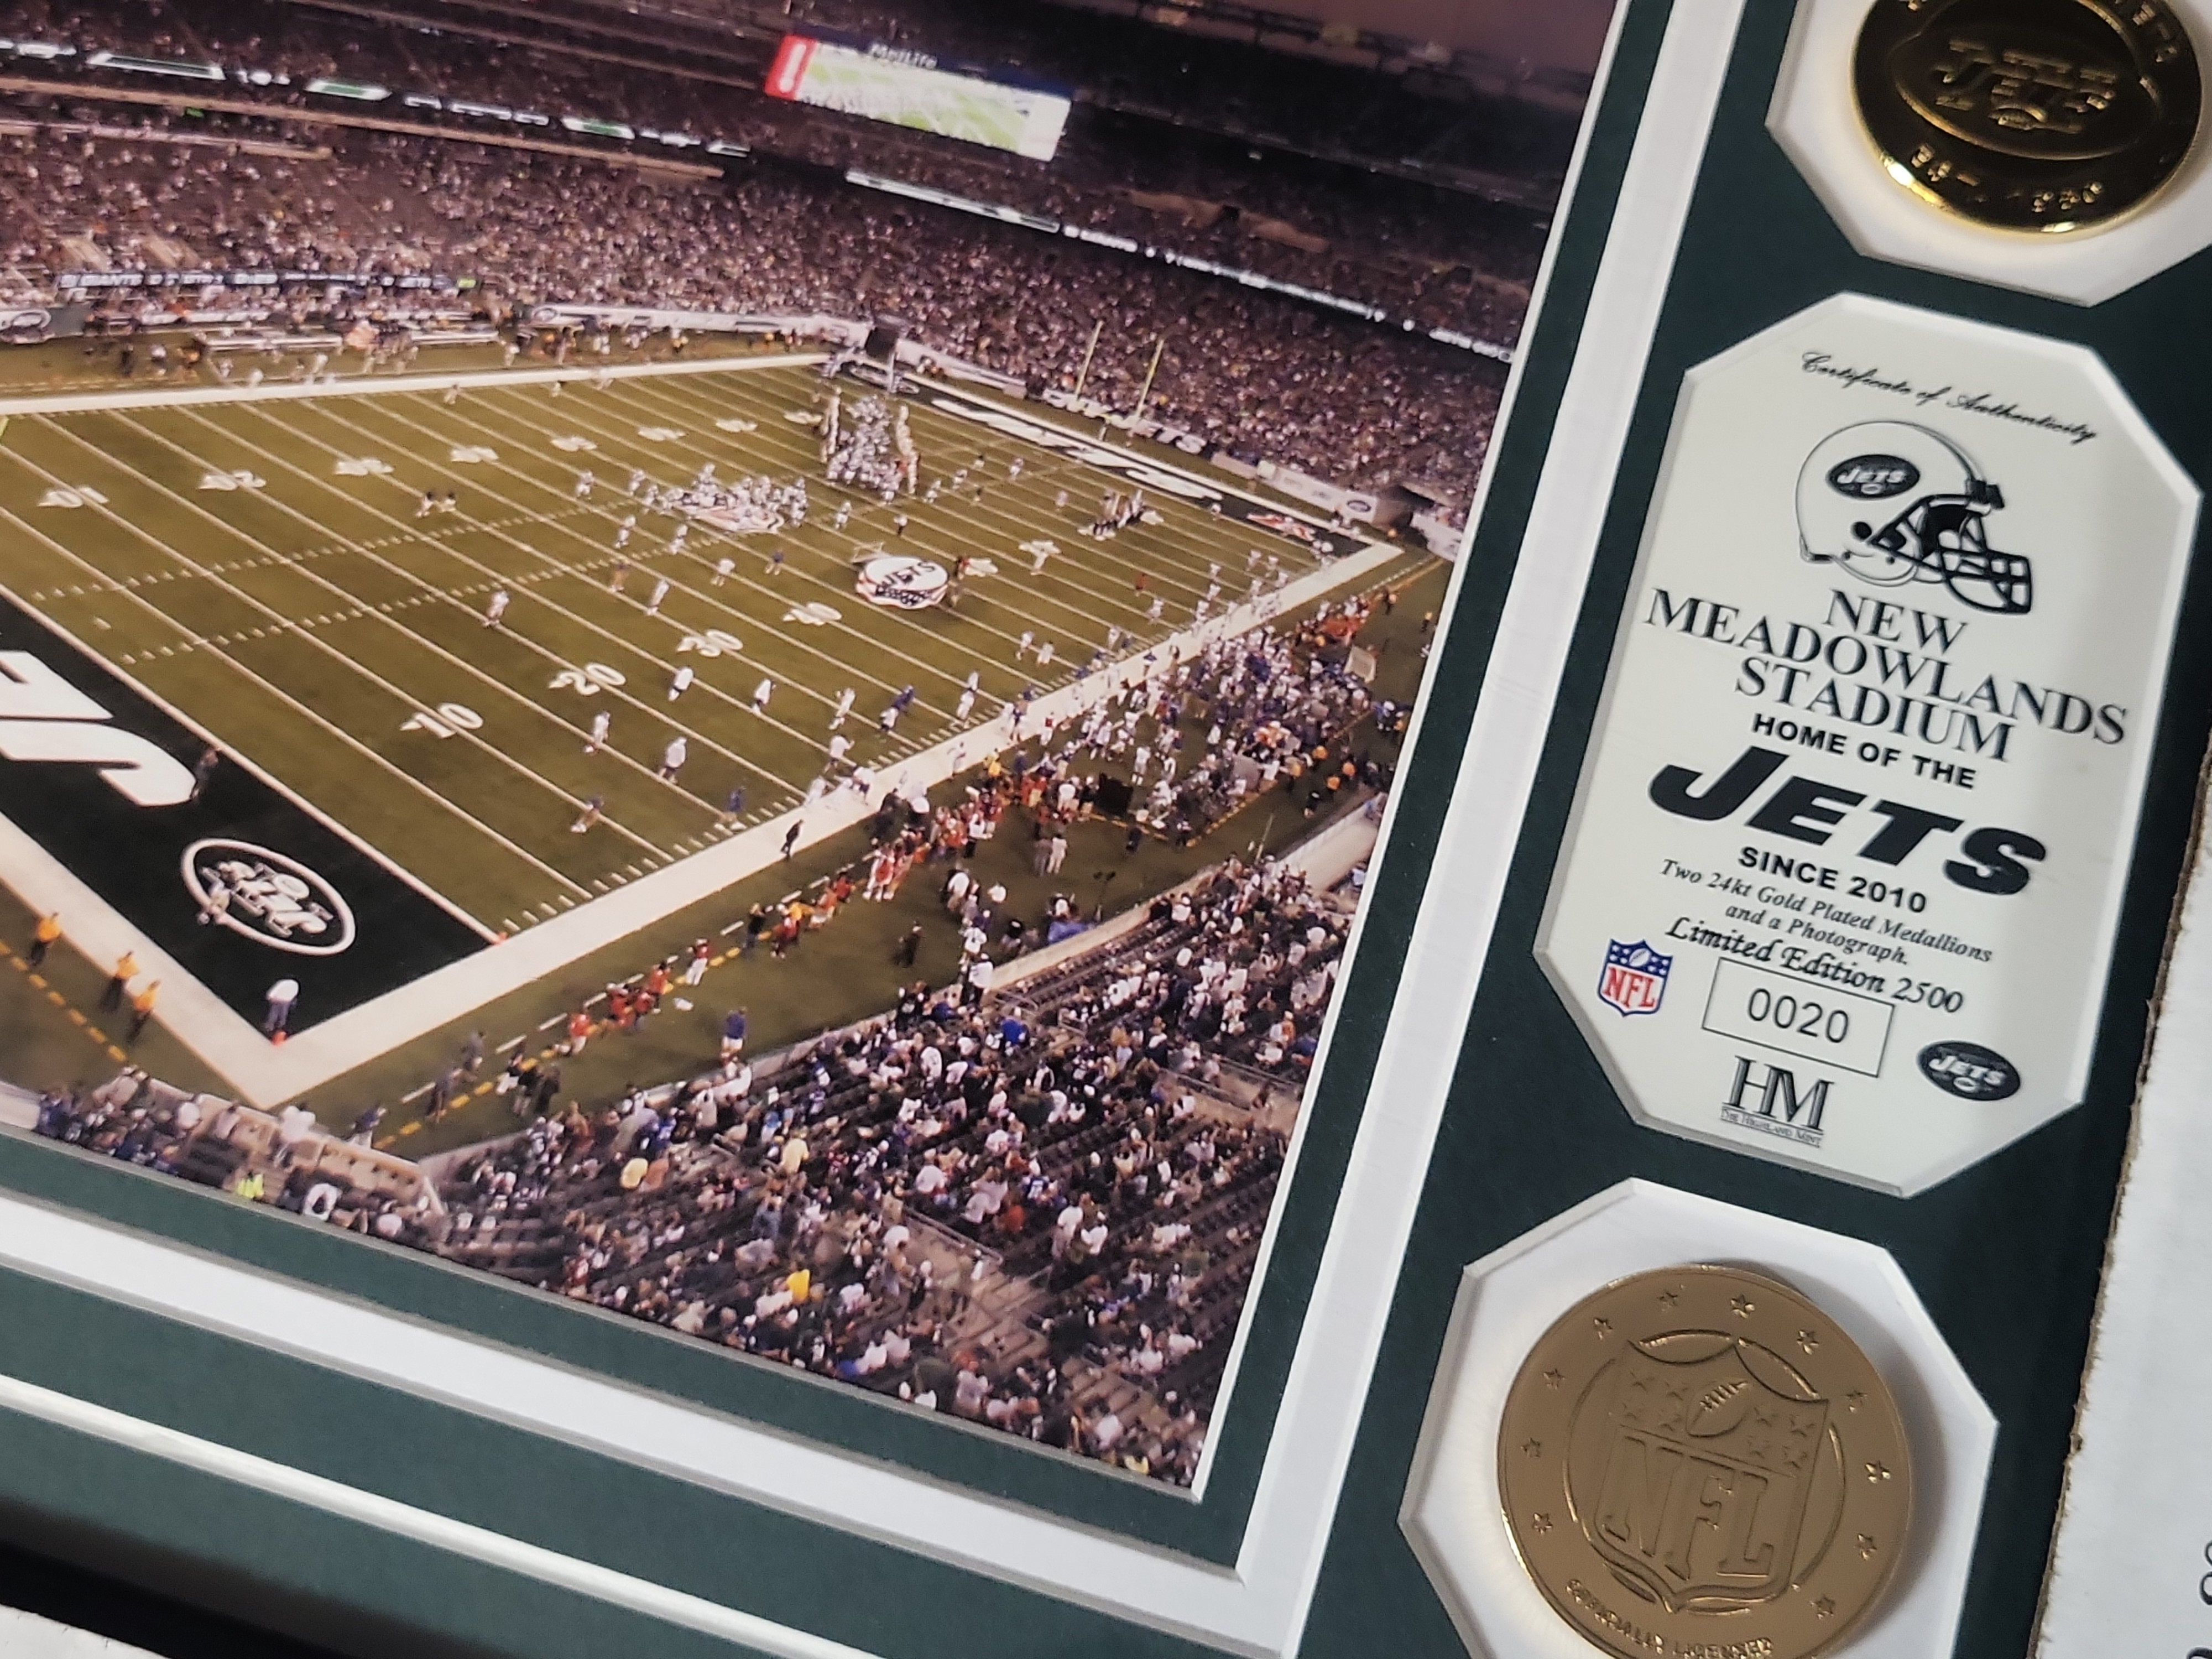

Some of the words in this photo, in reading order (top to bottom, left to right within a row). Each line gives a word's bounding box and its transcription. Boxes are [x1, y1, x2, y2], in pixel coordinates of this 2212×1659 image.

[1802, 352, 1911, 394] Certificate
[1916, 386, 1952, 406] of
[1946, 393, 2096, 445] Authenticity
[1835, 465, 1907, 485] JETS
[1824, 588, 1969, 655] NEW
[555, 662, 627, 696] 20
[1643, 587, 2128, 745] MEADOWLANDS
[413, 702, 484, 739] 10
[1734, 656, 2016, 763] STADIUM
[1751, 713, 1848, 756] HOME
[1858, 742, 1902, 768] OF
[1913, 754, 1977, 790] THE
[1648, 745, 2047, 896] JETS
[1661, 858, 1703, 884] Two
[1707, 872, 1753, 898] 24kt
[1757, 885, 1807, 912] Gold
[1810, 900, 1876, 931] Plated
[1877, 919, 1993, 963] Medallions
[1738, 846, 1839, 890] SINCE
[1846, 875, 1927, 913] 2010
[1665, 916, 1783, 962] Limited
[1780, 946, 1885, 993] Edition
[1891, 977, 1963, 1014] 2500
[1725, 905, 1767, 925] and
[1768, 916, 1782, 930] a
[1786, 917, 1908, 966] Photograph.
[1604, 966, 1658, 1008] NFL
[1747, 988, 1849, 1044] 0020
[1721, 1055, 1835, 1132] HM
[1928, 1055, 2007, 1087] JETS
[1600, 1434, 1775, 1582] NFL
